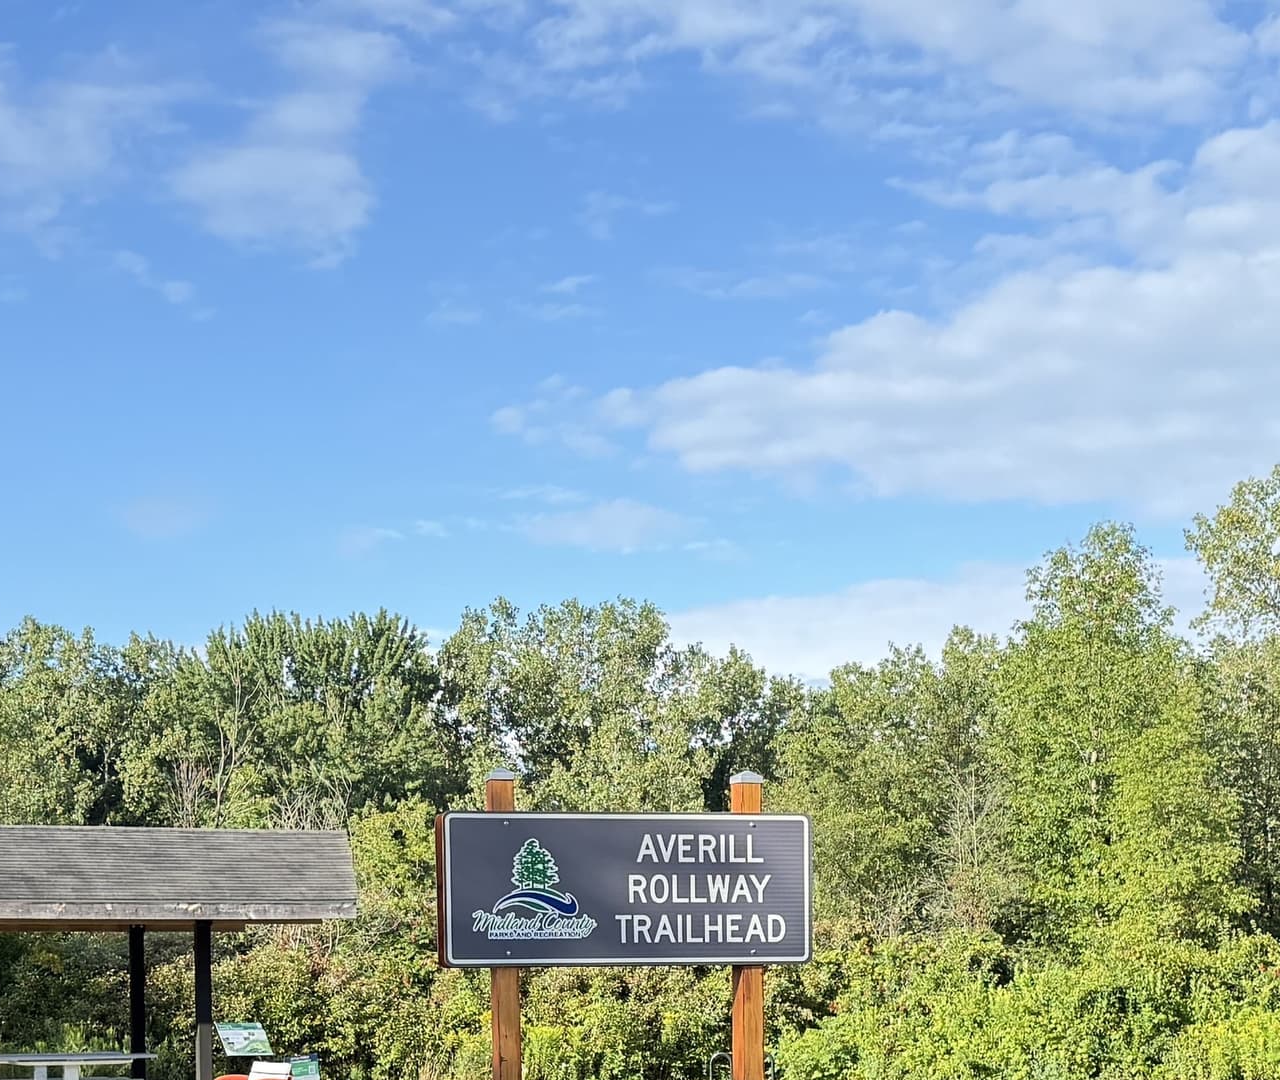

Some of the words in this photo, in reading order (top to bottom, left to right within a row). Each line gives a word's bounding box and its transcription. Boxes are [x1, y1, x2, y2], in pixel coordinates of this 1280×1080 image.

[636, 834, 764, 863] AVERILL
[628, 874, 771, 904] ROLLWAY
[472, 910, 543, 932] Midland
[542, 912, 597, 938] County
[615, 914, 786, 944] TRAILHEAD
